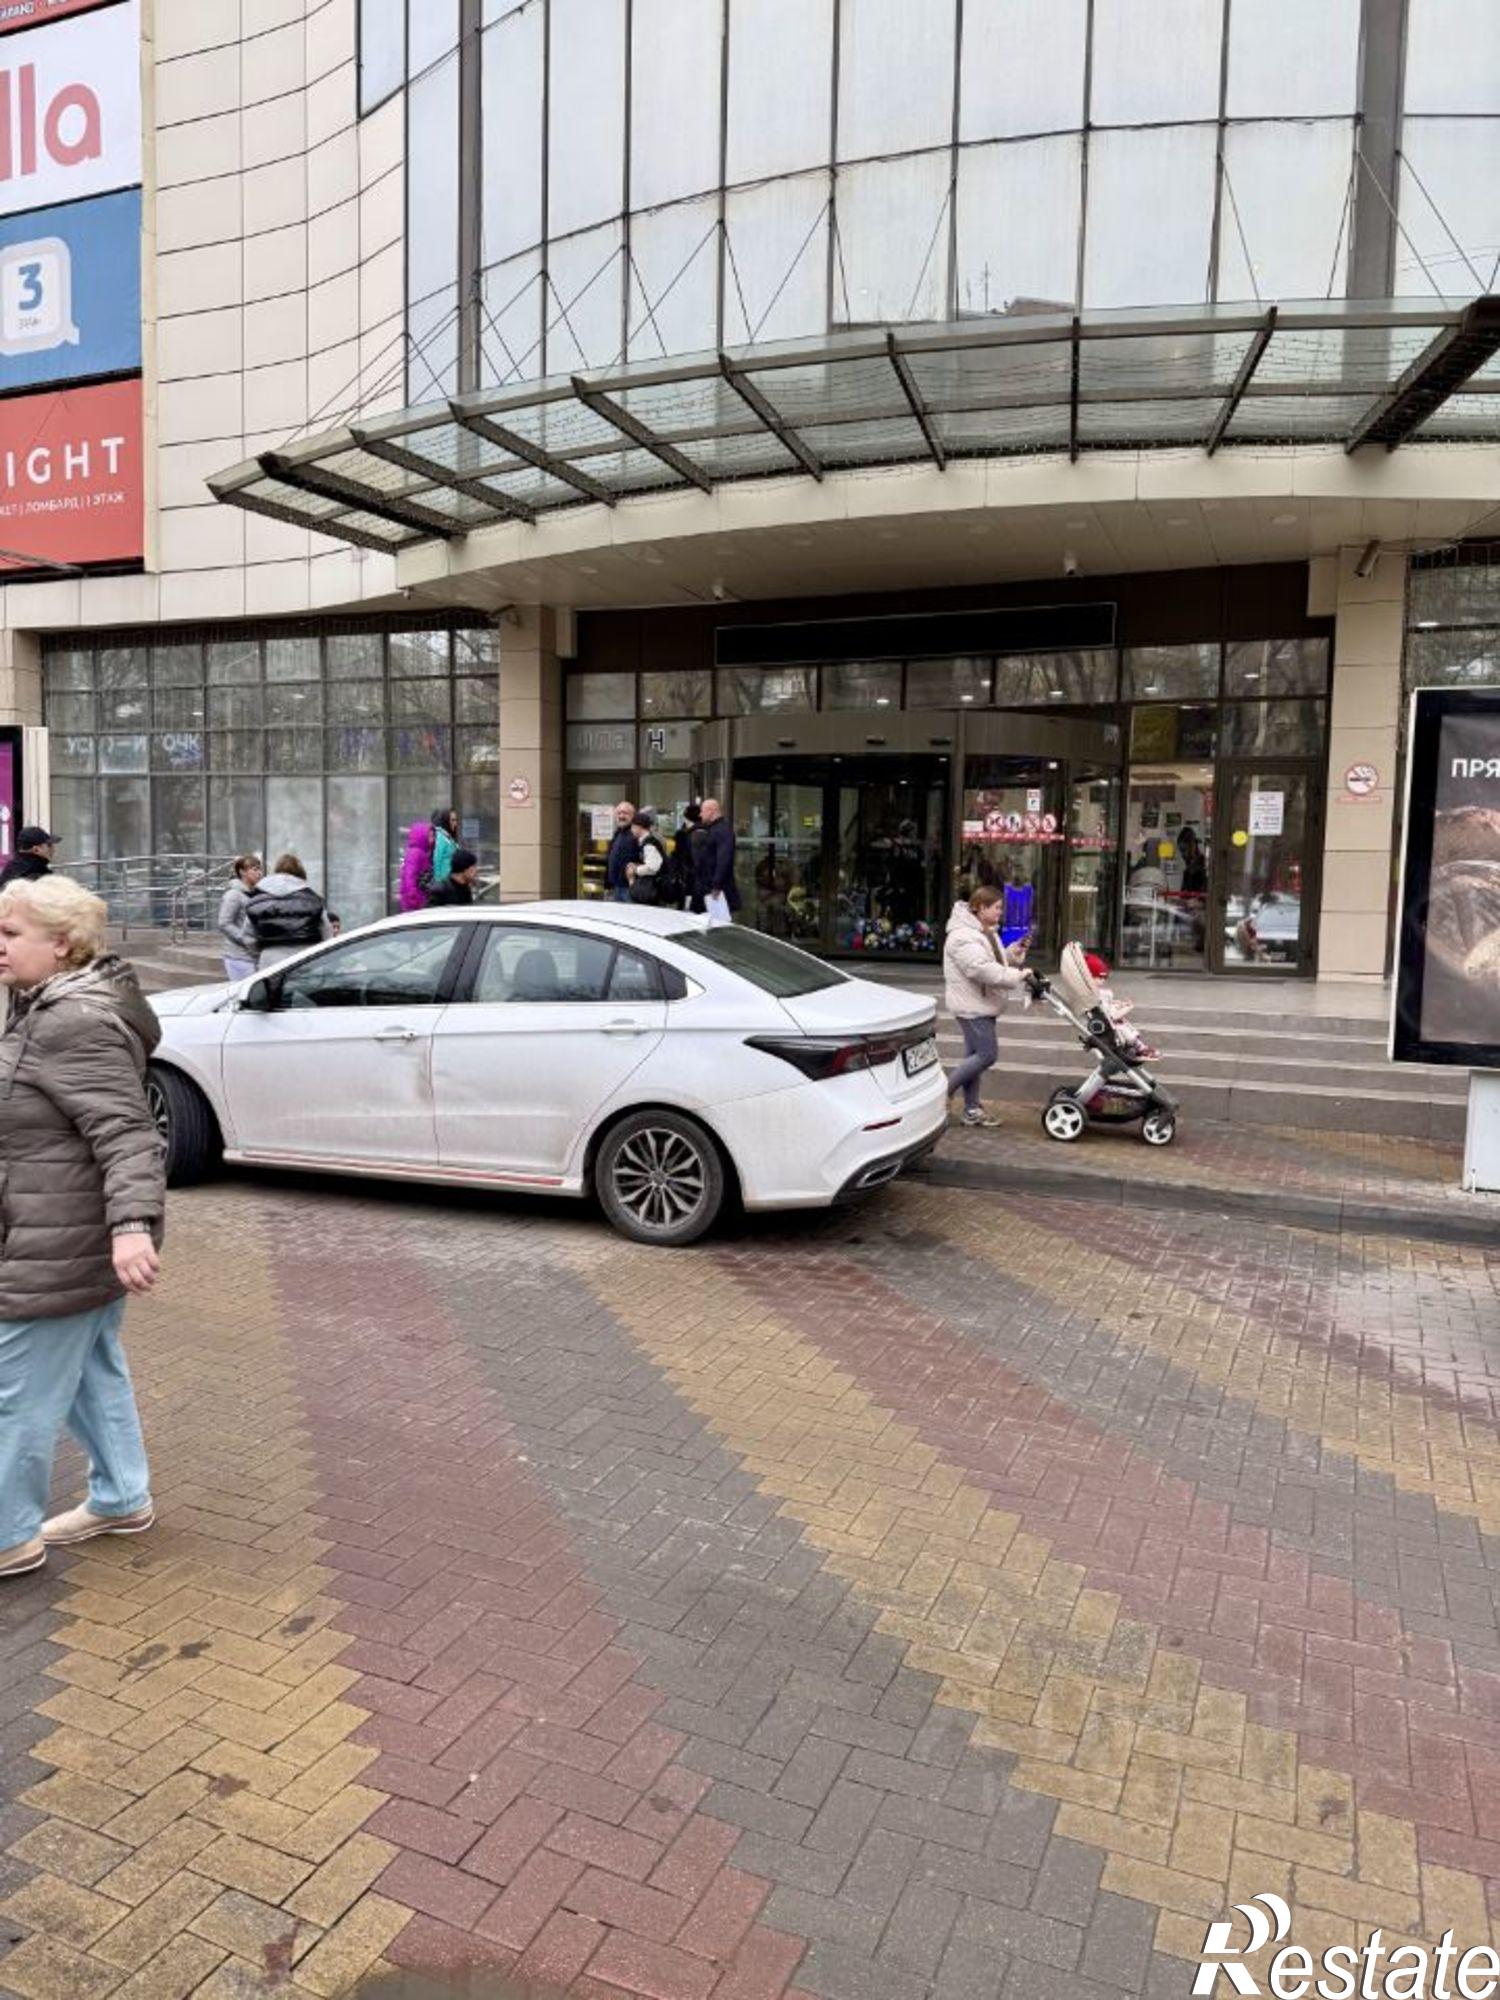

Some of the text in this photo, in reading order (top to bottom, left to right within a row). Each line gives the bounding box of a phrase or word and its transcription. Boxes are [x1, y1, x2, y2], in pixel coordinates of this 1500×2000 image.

[18, 262, 42, 311] 3
[6, 437, 125, 489] IGHT
[1451, 758, 1500, 778] ПРЯ
